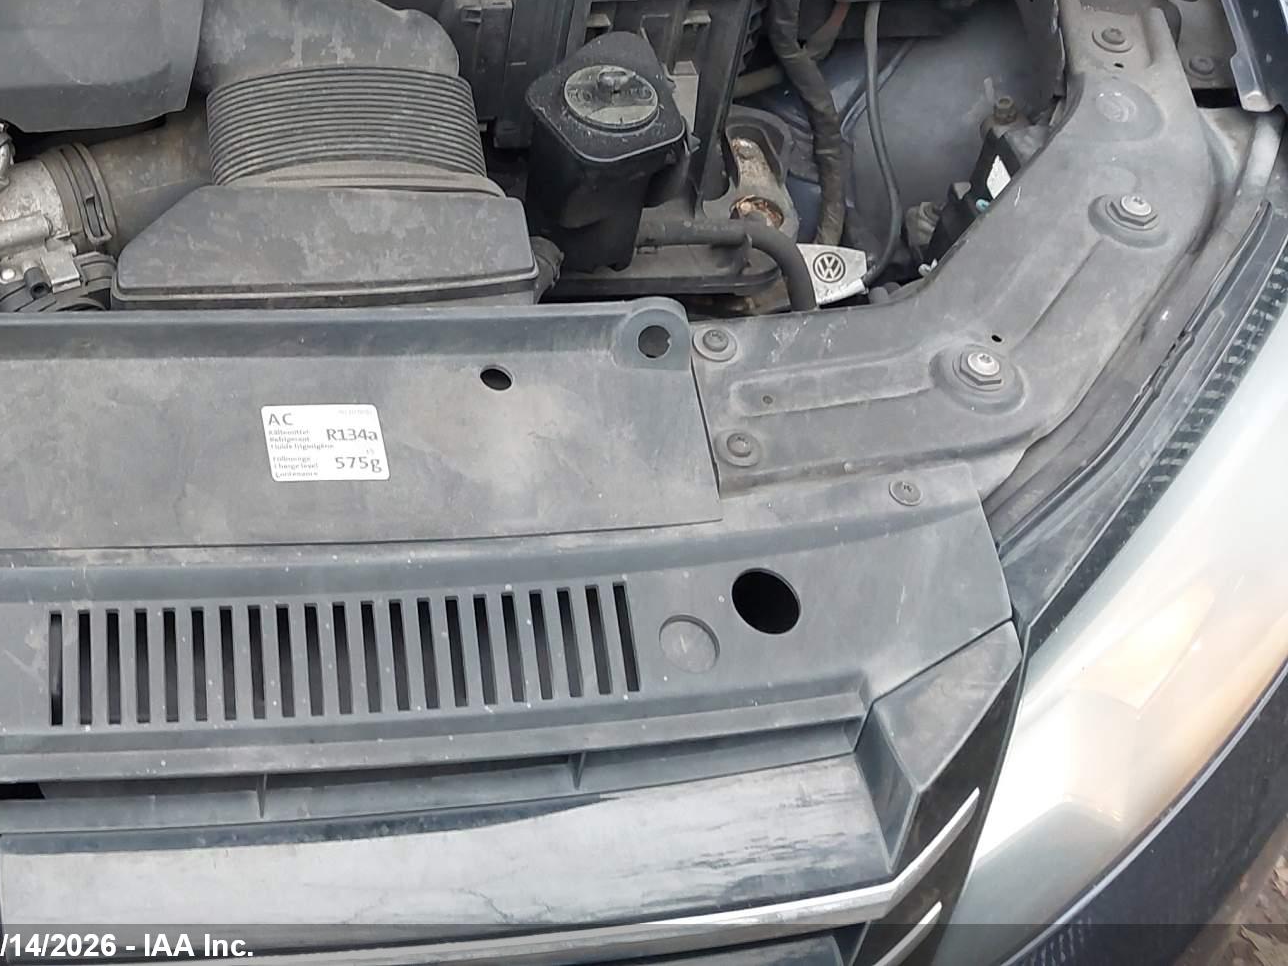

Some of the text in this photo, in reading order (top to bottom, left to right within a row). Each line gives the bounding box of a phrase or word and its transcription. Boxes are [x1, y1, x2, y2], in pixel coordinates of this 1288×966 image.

[268, 412, 294, 426] AC
[326, 428, 378, 441] R134a
[335, 456, 383, 473] 575g
